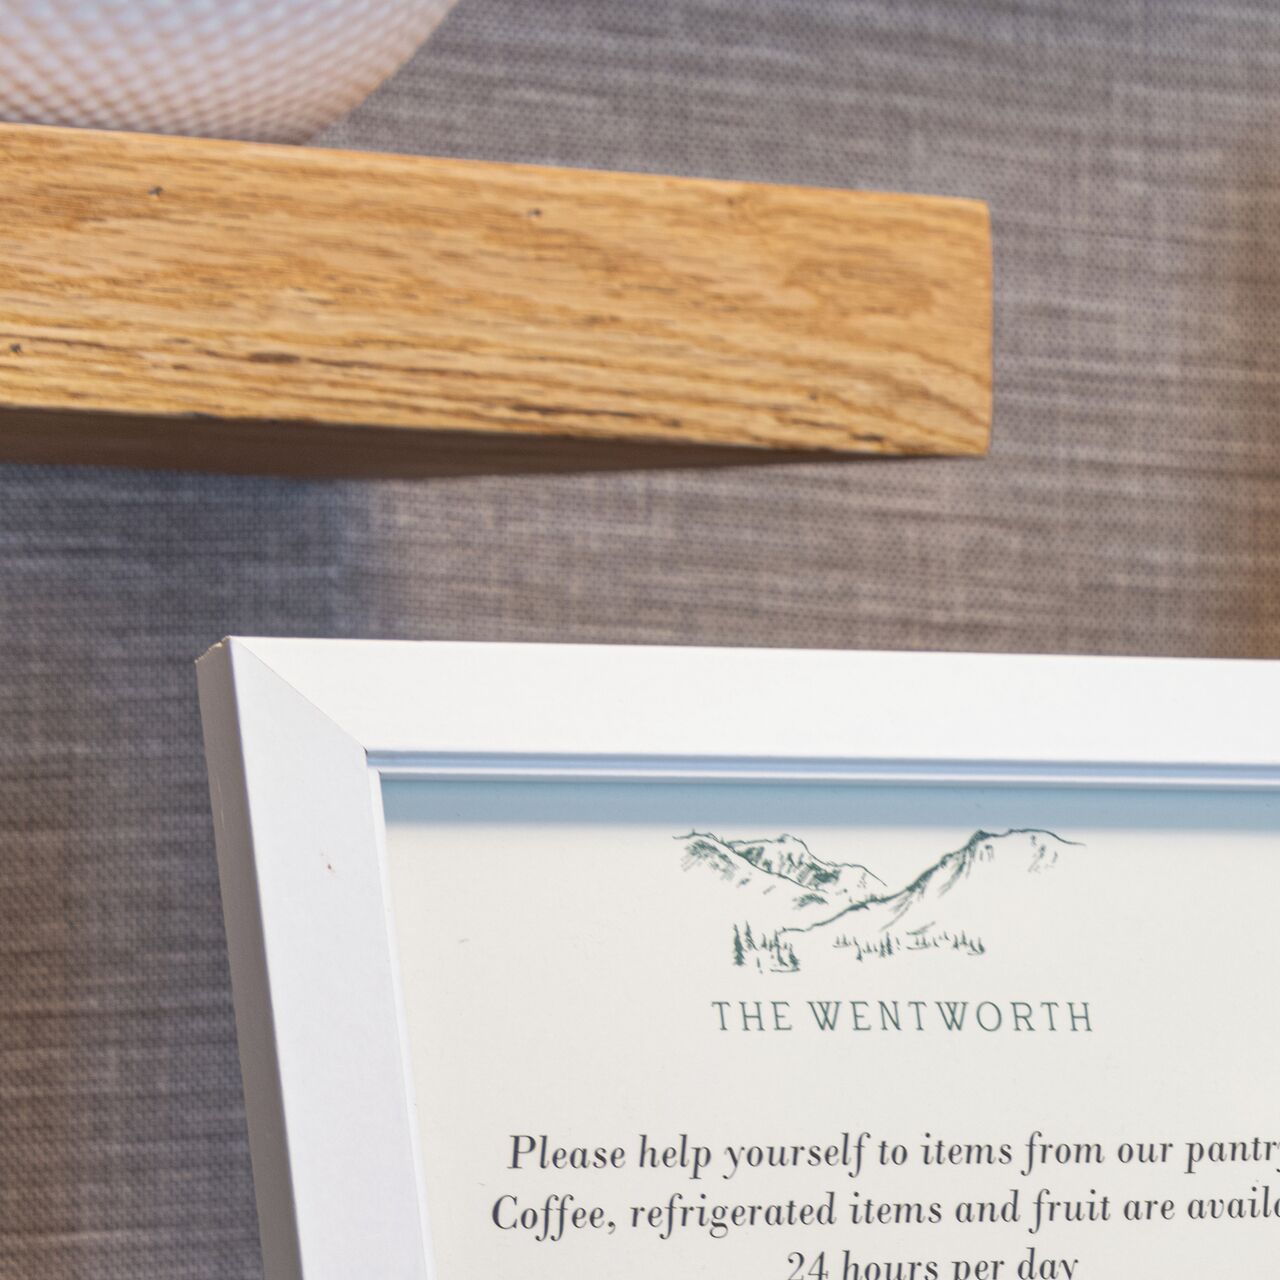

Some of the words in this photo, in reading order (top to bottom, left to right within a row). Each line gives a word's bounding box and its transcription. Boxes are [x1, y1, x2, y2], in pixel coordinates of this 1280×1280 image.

[711, 1000, 792, 1032] THE
[806, 1000, 1093, 1033] WENTWORTH
[506, 1134, 626, 1170] Please
[638, 1133, 712, 1180] help
[722, 1131, 872, 1180] yourself
[878, 1140, 909, 1166] to
[920, 1131, 1013, 1166] items
[1020, 1130, 1105, 1177] from
[1117, 1142, 1174, 1164] our
[491, 1193, 616, 1242] Coffee,
[630, 1191, 836, 1241] refrigerated
[848, 1191, 943, 1225] items
[954, 1188, 1021, 1224] and
[1027, 1188, 1111, 1235] fruit
[1123, 1199, 1175, 1222] are
